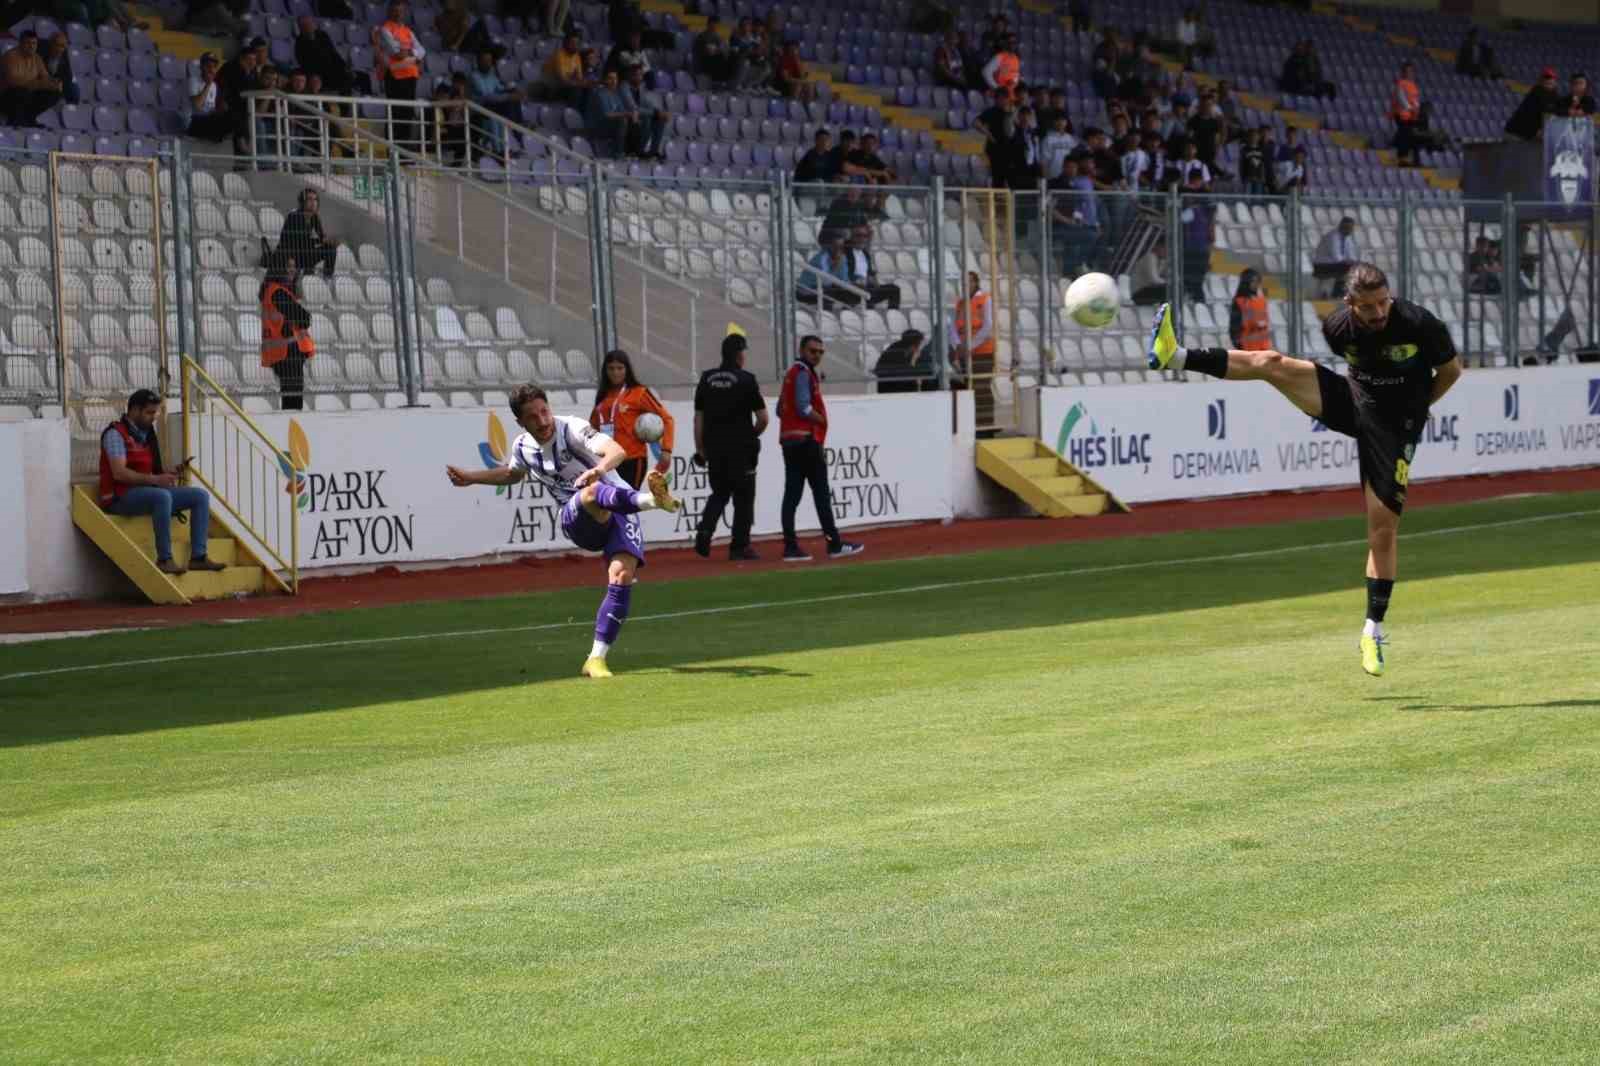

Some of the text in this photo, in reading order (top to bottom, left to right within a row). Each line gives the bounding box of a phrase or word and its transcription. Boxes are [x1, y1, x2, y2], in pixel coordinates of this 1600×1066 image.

[1070, 427, 1152, 474] HES İLAÇ
[1475, 429, 1548, 457] DERMAVIA
[1172, 448, 1261, 480] DERMAVIA
[307, 469, 388, 513] PARK
[310, 514, 414, 560] AFYON
[508, 505, 570, 544] AFY
[625, 522, 642, 543] 34
